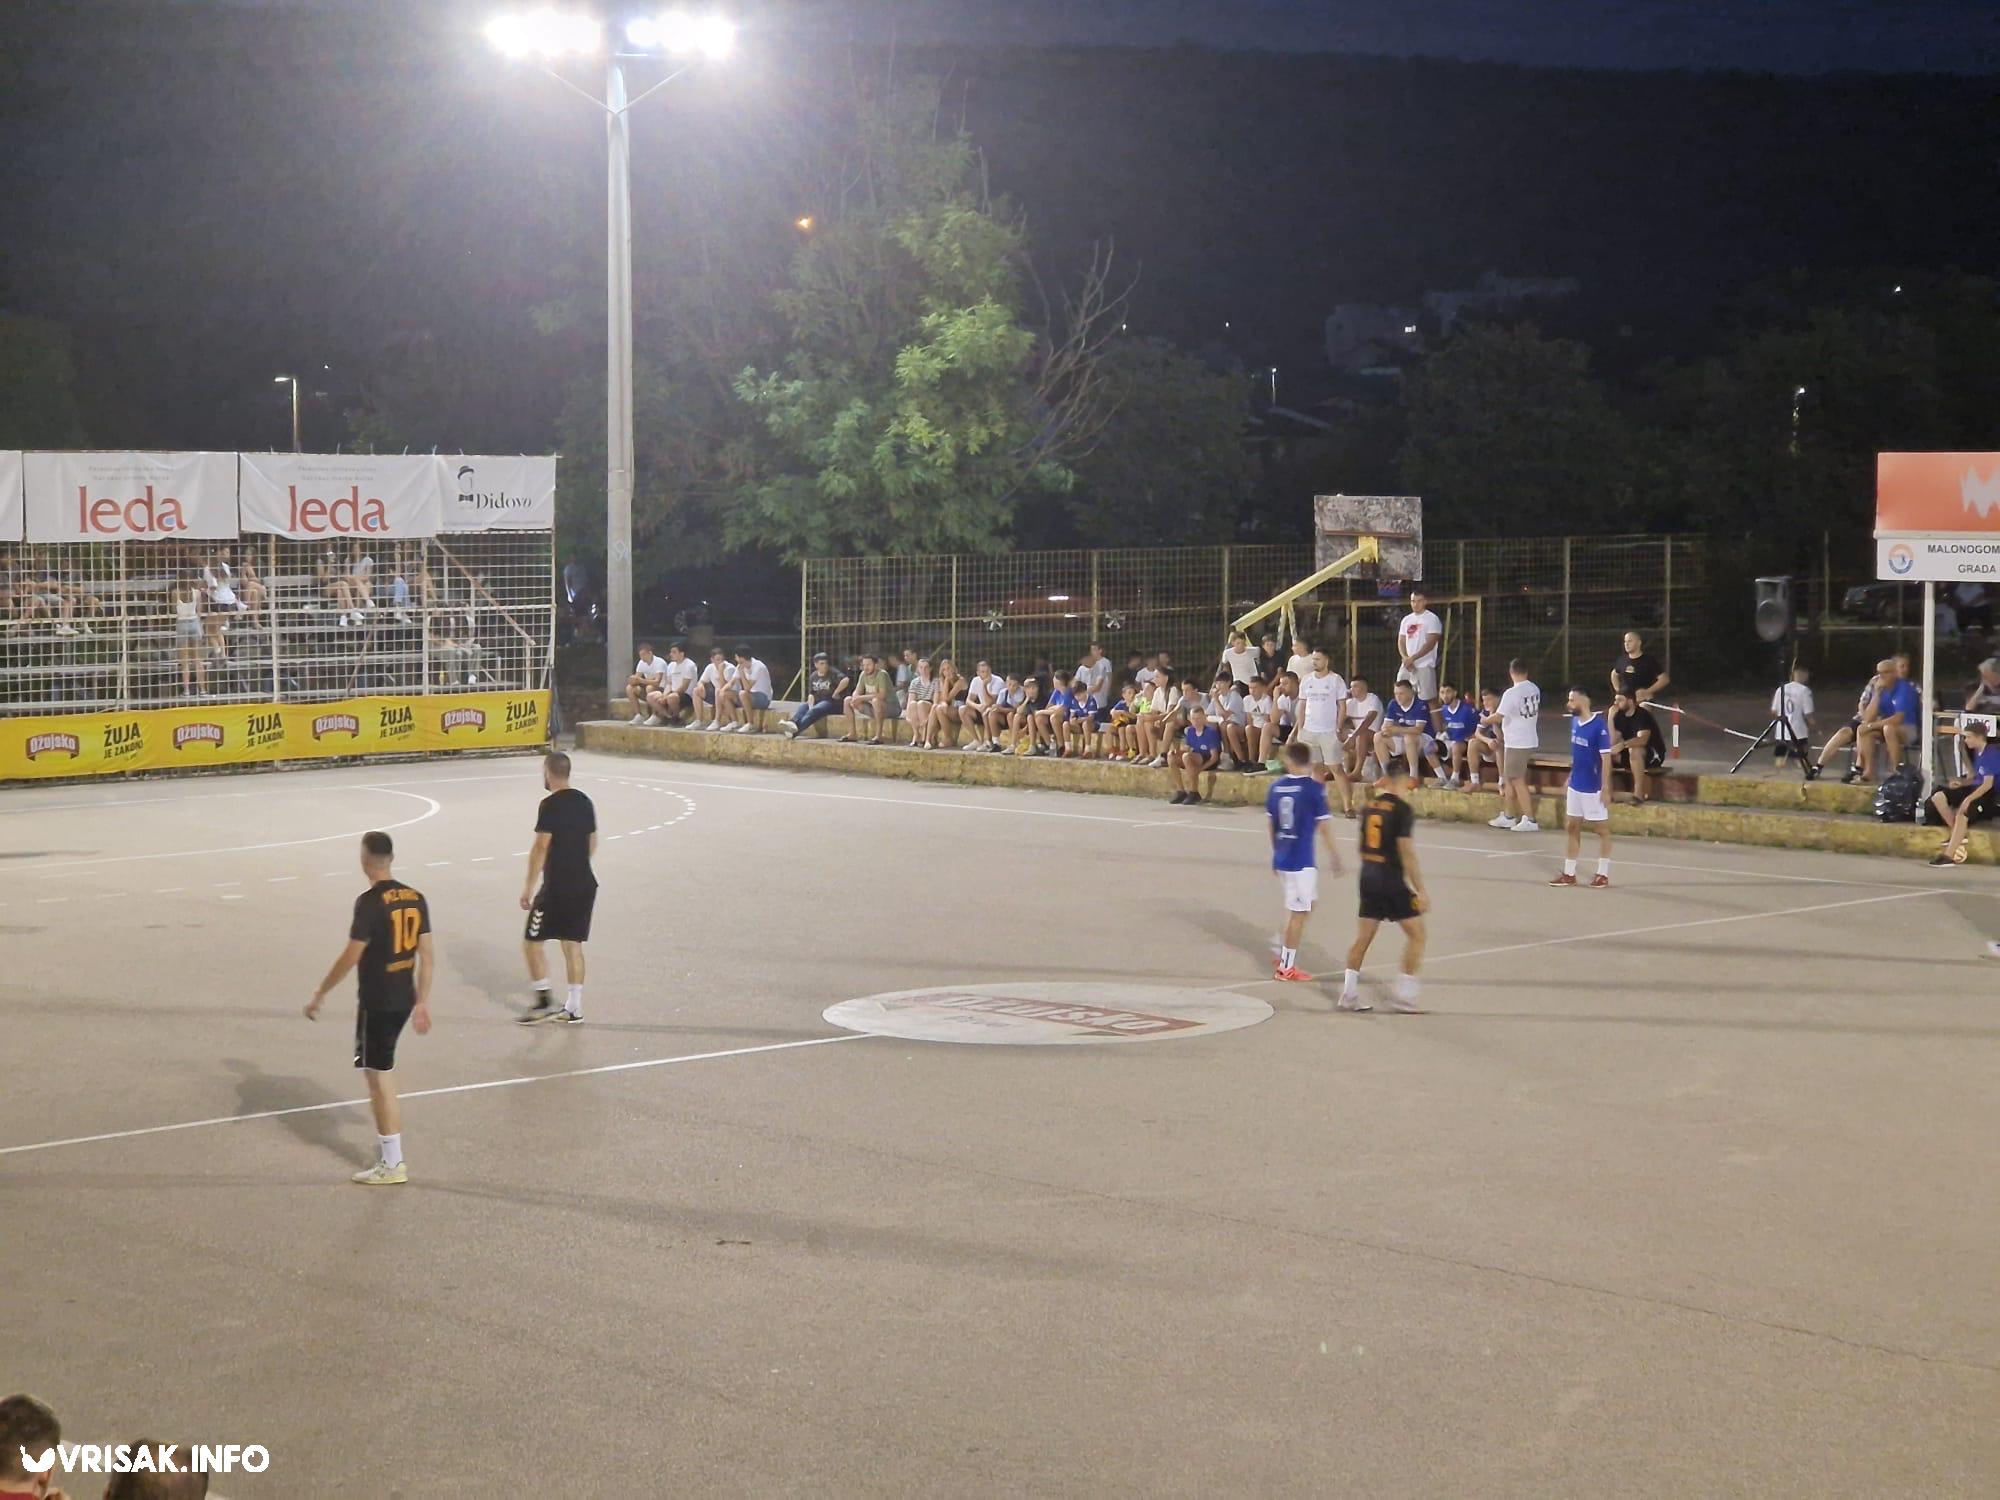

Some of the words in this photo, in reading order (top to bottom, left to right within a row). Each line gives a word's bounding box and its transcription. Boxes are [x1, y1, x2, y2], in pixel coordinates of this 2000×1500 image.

[78, 485, 188, 533] leda
[288, 485, 390, 533] leda
[476, 492, 532, 509] Didovo
[1958, 564, 1996, 574] GRADA
[380, 705, 413, 727] ŽUJA
[505, 700, 537, 722] ŽUJA
[104, 722, 141, 748] ŽUJA
[247, 712, 282, 737] ŽUJA
[391, 907, 421, 954] 10
